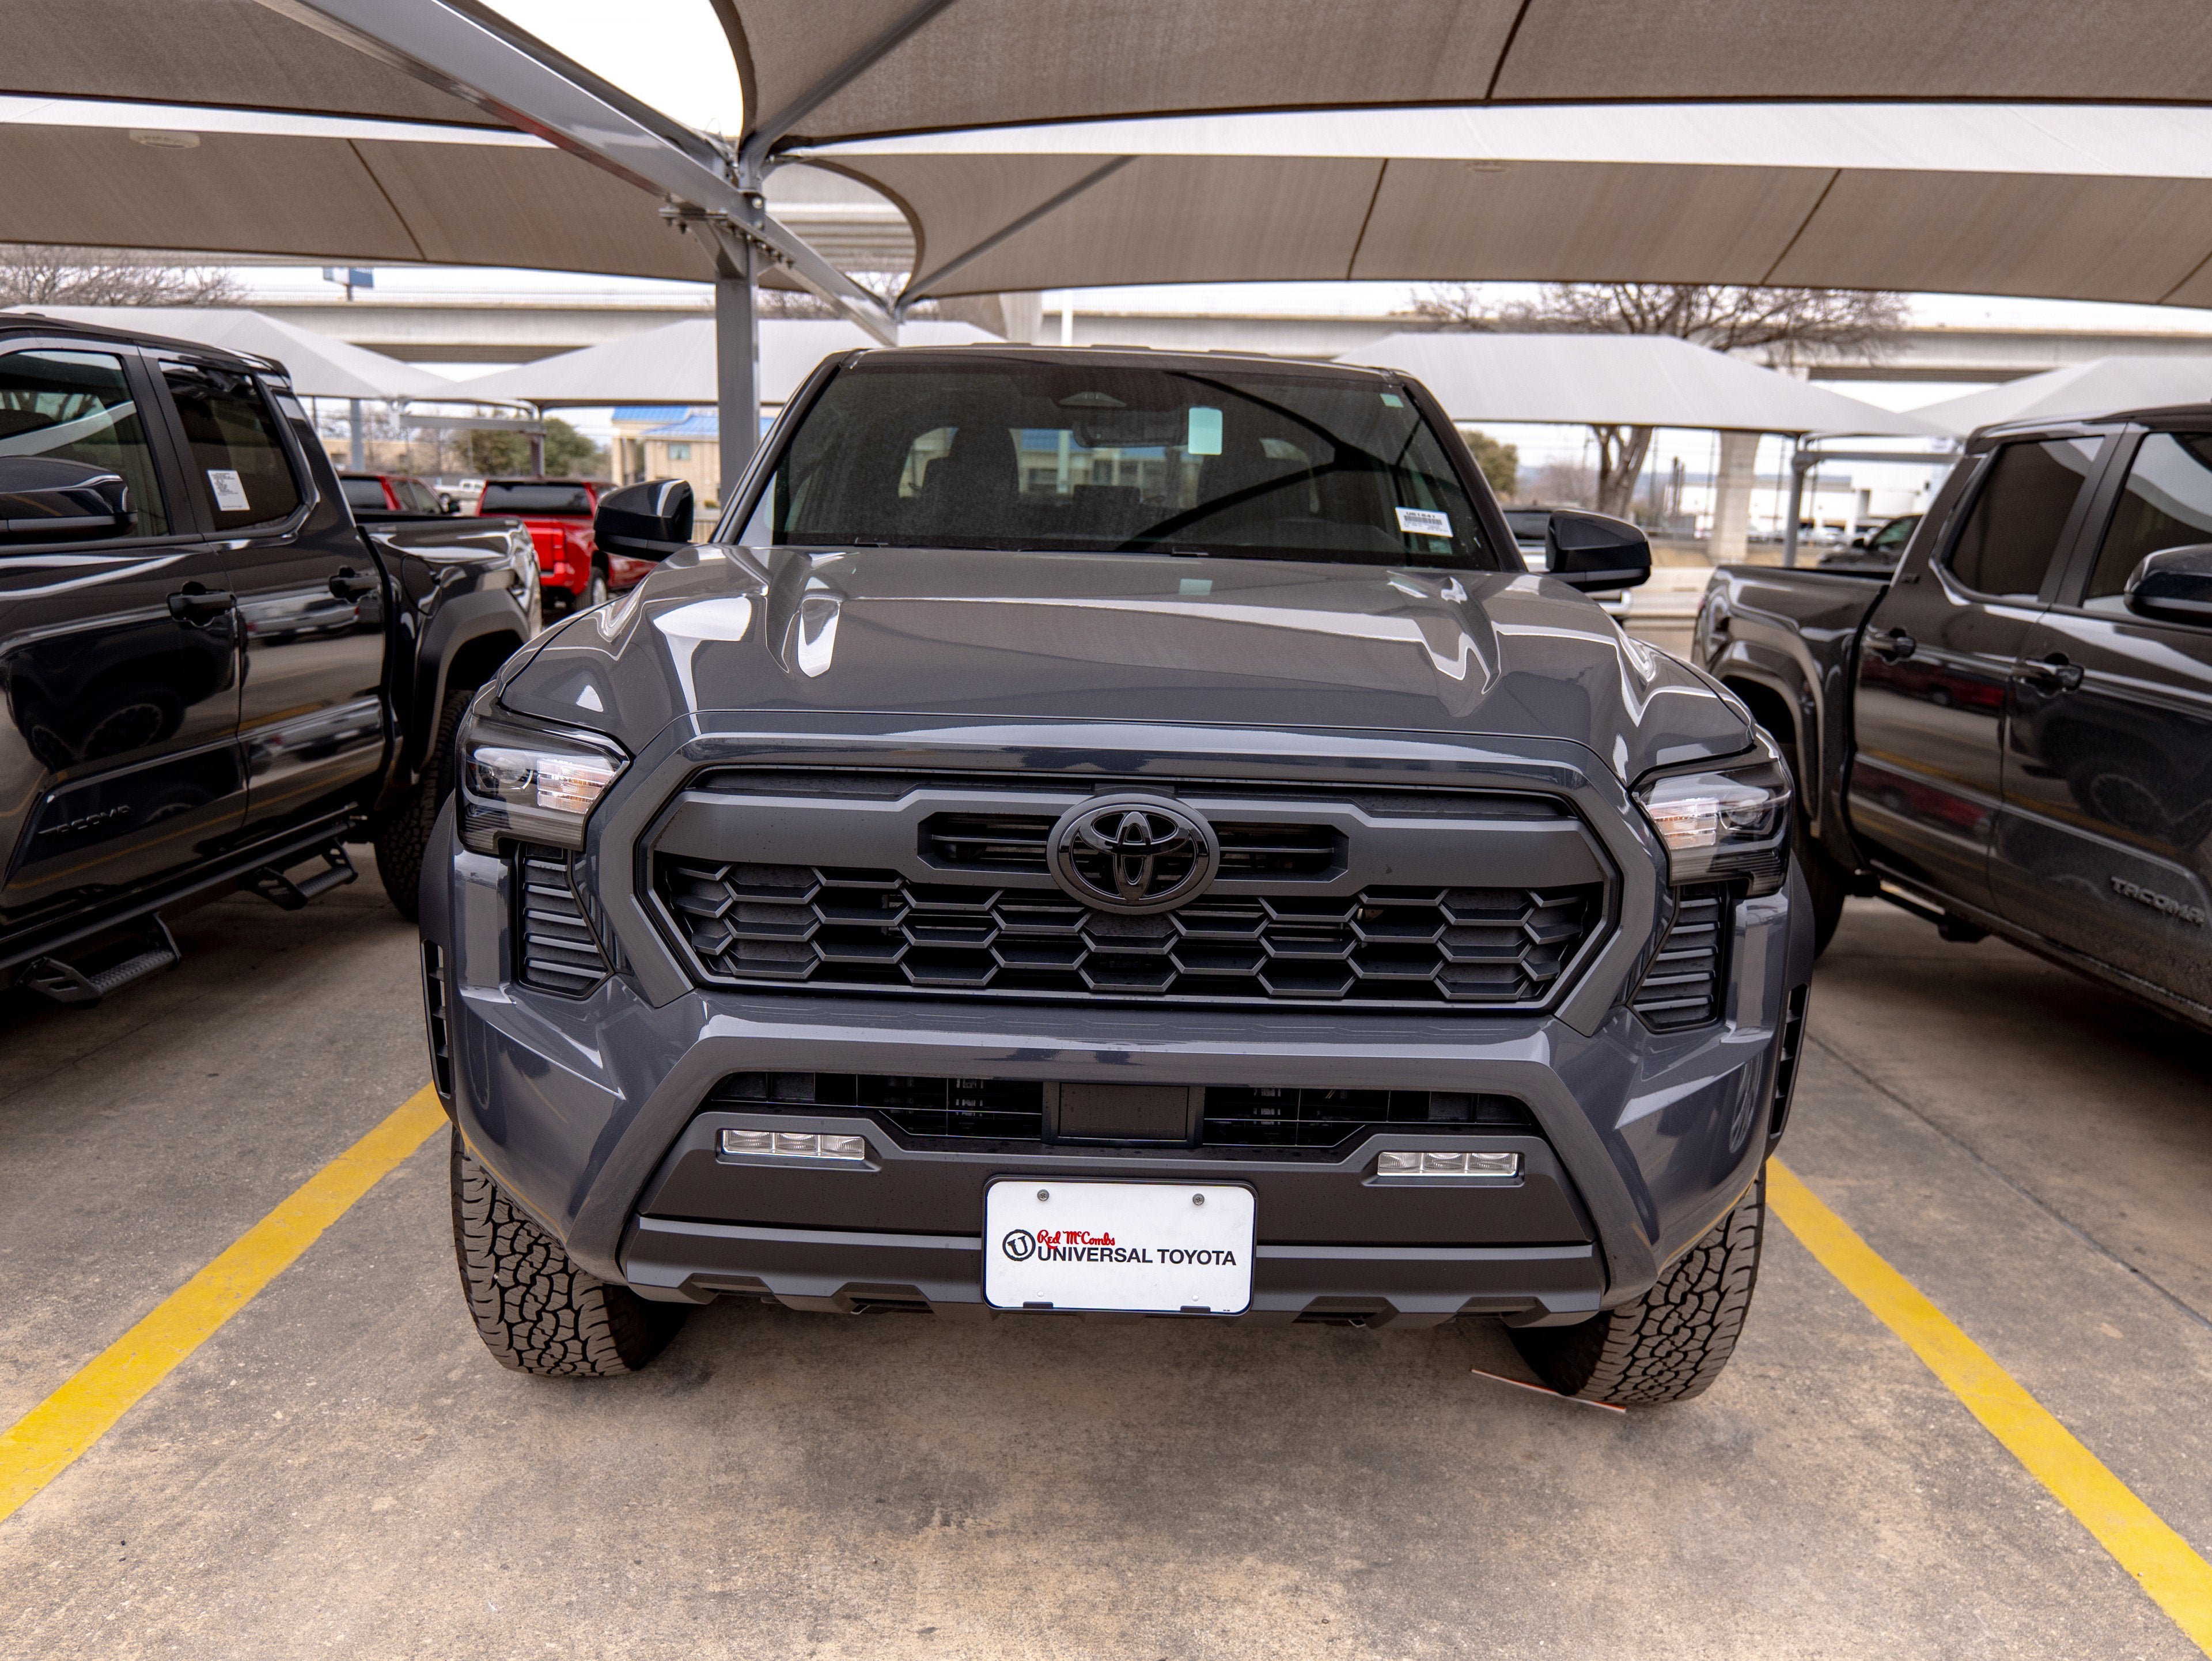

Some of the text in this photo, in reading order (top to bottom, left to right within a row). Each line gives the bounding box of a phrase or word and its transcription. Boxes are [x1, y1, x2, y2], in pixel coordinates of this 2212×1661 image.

[2110, 875, 2205, 926] TACOMA
[1037, 1229, 1116, 1249] Red McCombs
[1037, 1246, 1237, 1266] UNIVERSAL TOYOTA
